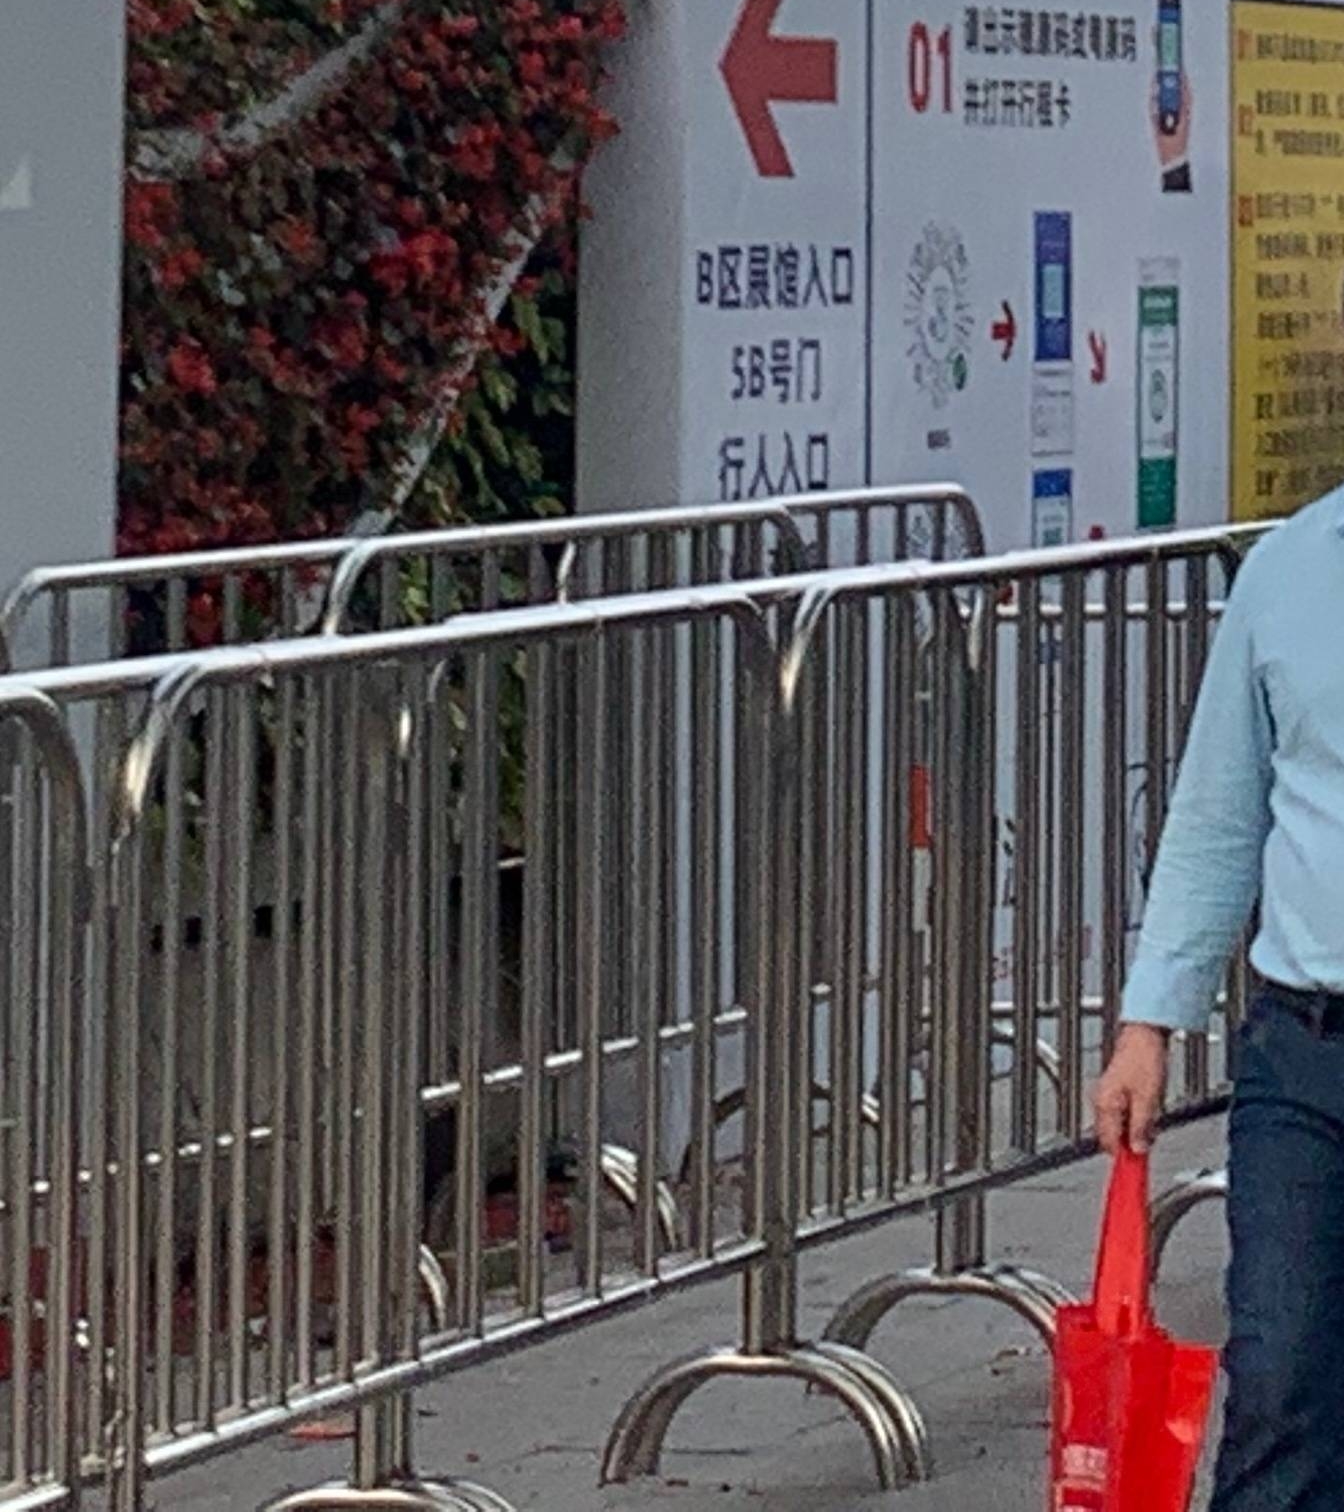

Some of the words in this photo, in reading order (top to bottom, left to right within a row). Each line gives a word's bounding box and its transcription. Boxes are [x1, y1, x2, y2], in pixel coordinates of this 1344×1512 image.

[908, 20, 953, 113] 01
[696, 241, 854, 310] B区展馆入口
[718, 431, 830, 501] 行人入口
